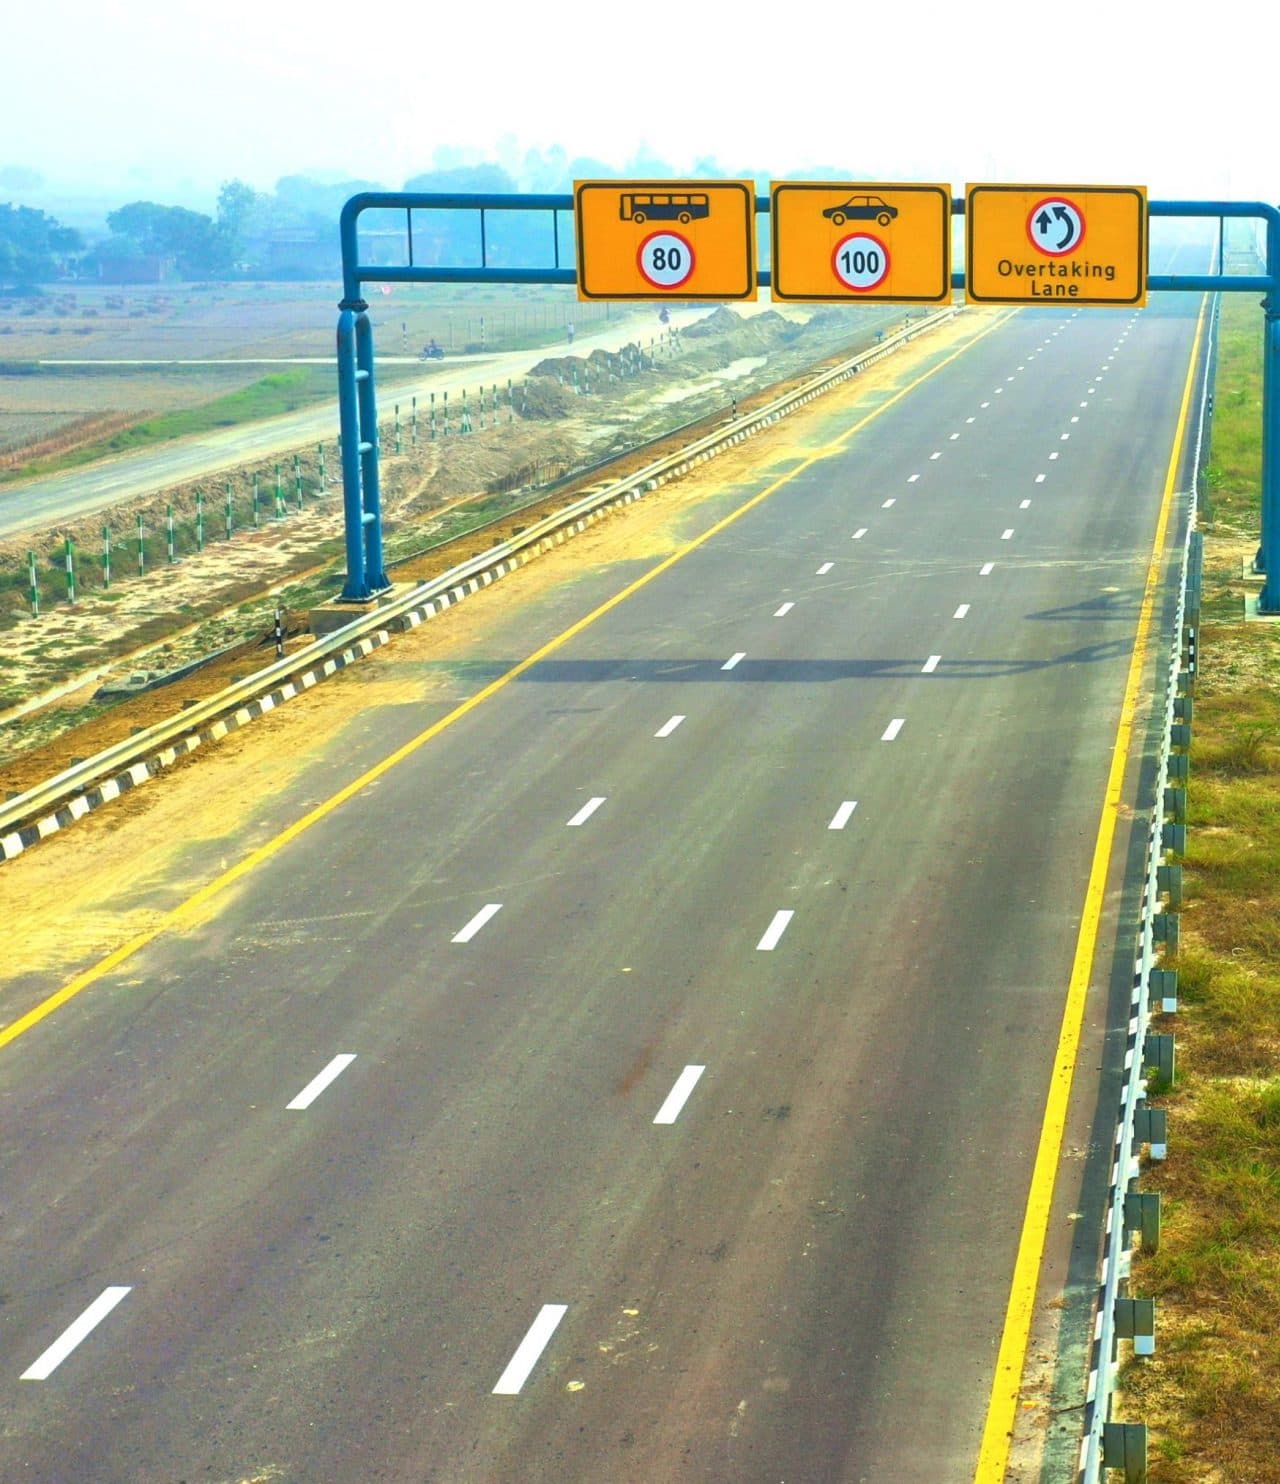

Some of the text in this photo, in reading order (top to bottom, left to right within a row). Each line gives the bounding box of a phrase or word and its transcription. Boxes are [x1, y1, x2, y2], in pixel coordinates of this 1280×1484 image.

[652, 247, 682, 271] 80
[840, 250, 879, 274] 100
[997, 259, 1116, 281] Overtaking
[1031, 280, 1079, 297] Lane
